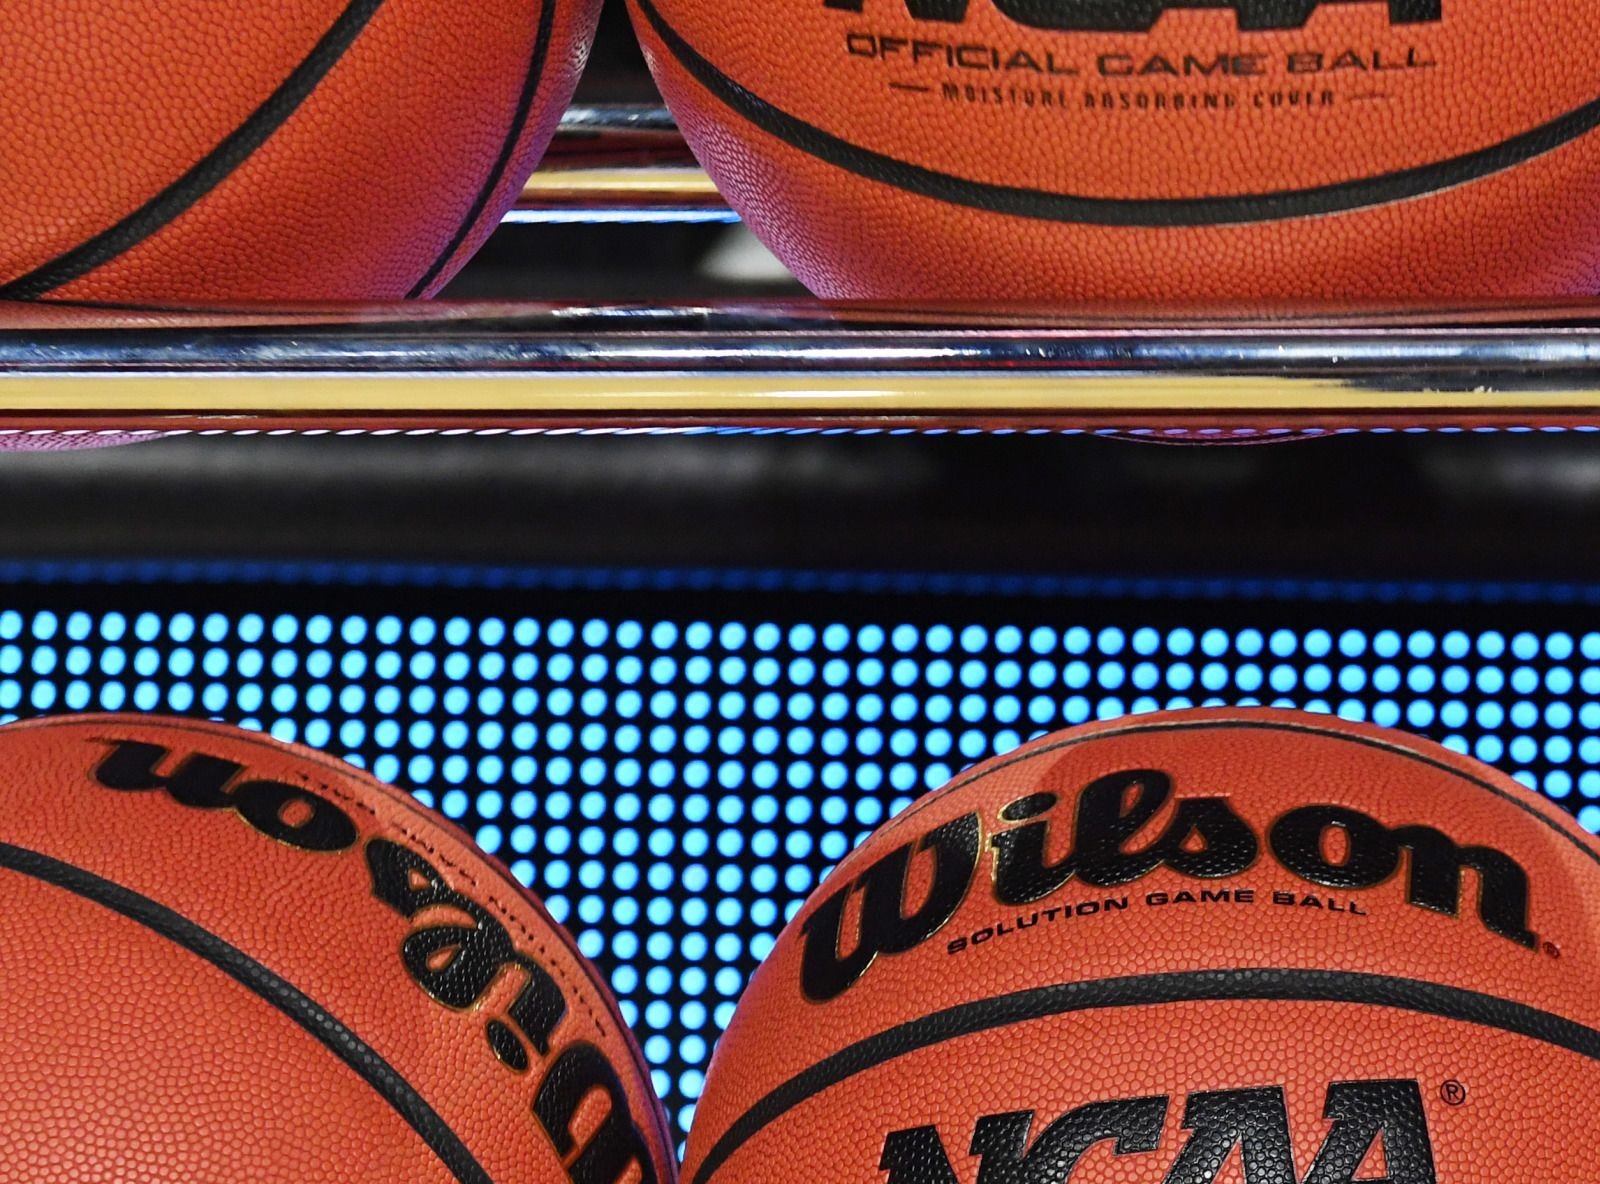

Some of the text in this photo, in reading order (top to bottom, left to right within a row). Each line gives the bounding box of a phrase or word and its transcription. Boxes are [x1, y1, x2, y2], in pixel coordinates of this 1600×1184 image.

[846, 32, 1438, 76] OFFICIAL GAME BALL
[942, 80, 1069, 108] MOISTURE
[799, 767, 1542, 1003] Wilson
[946, 888, 1368, 955] SOLUTION GAME BALL
